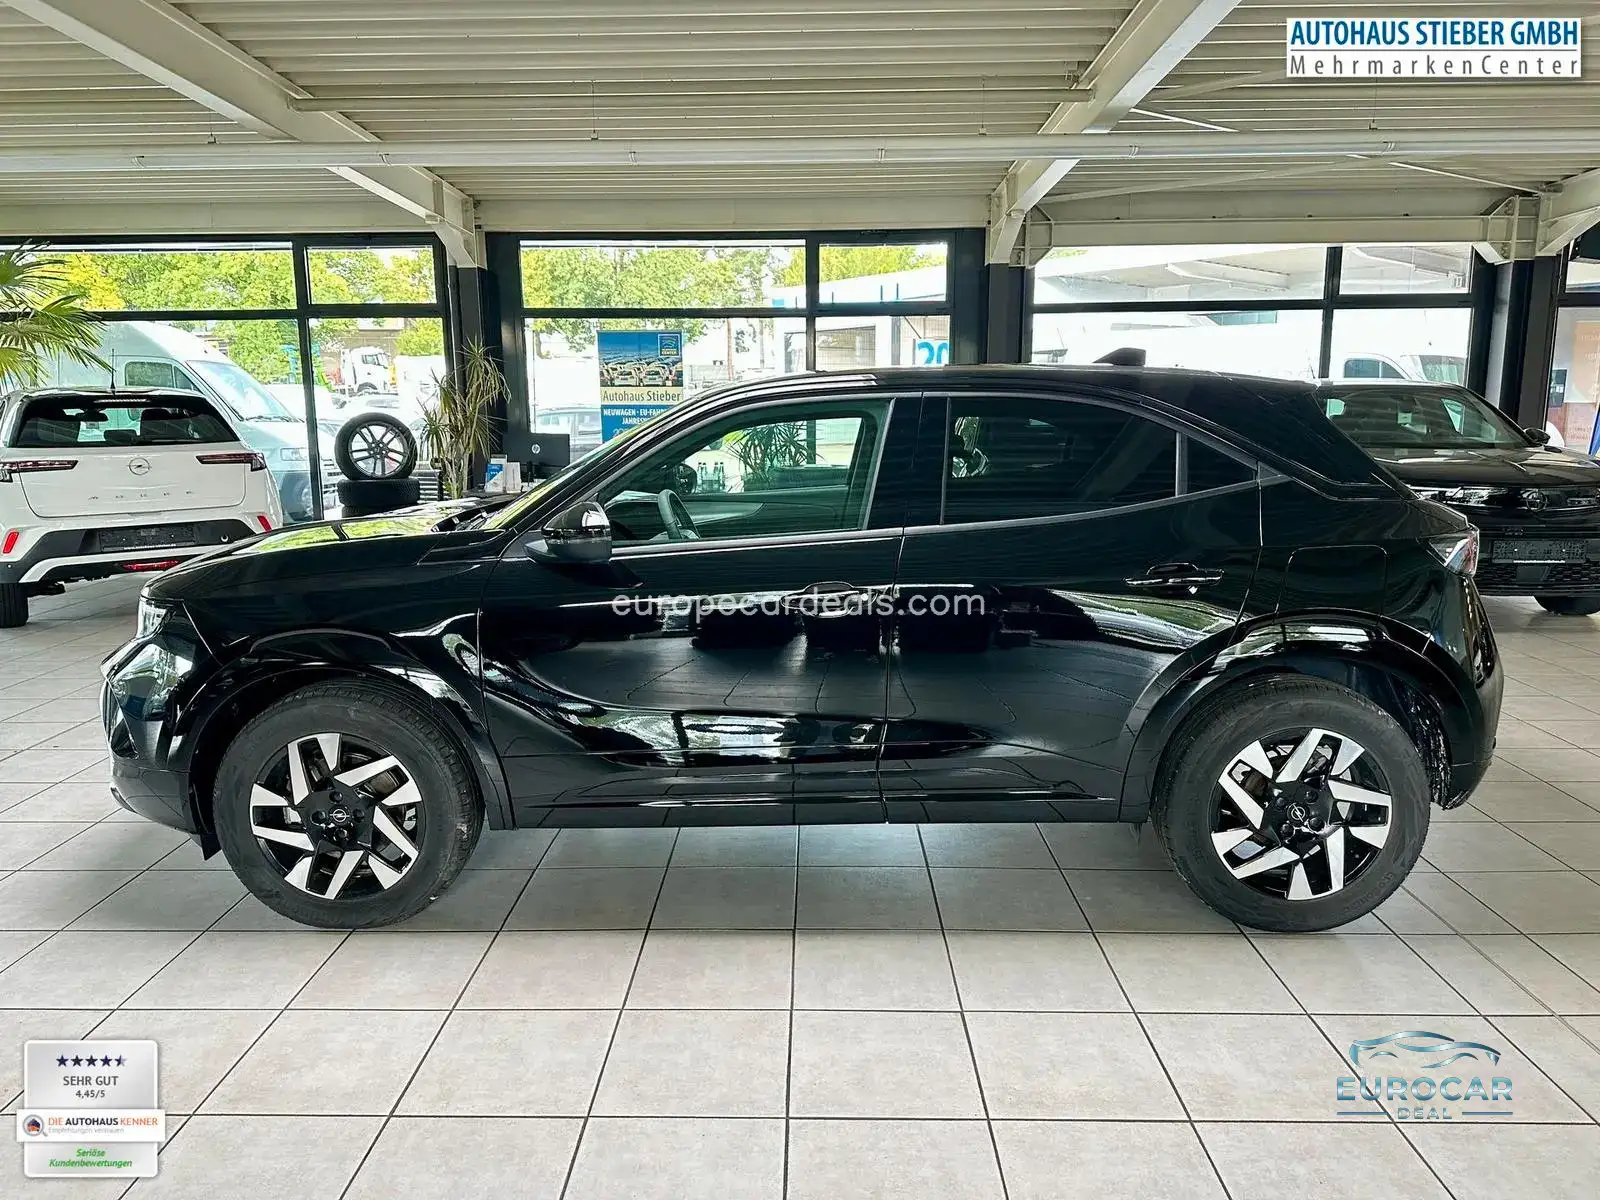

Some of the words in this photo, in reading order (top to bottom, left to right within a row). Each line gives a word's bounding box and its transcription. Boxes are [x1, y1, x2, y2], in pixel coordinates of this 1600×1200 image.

[603, 391, 645, 402] Autohaus
[646, 390, 681, 402] Stieber
[603, 409, 636, 417] NEUWAGEN
